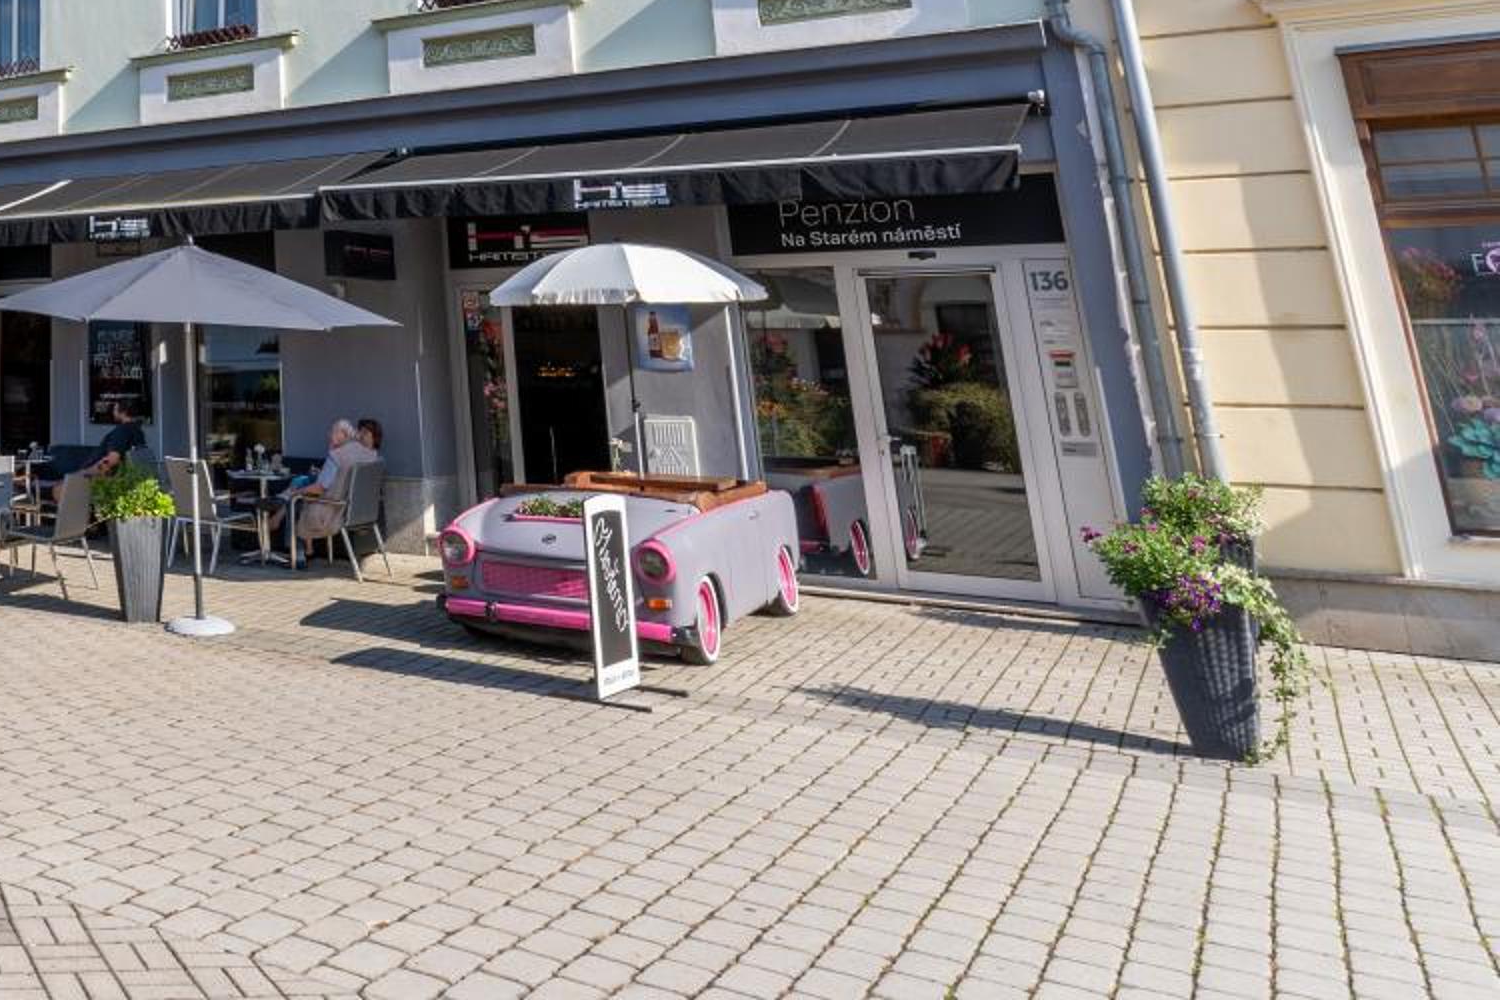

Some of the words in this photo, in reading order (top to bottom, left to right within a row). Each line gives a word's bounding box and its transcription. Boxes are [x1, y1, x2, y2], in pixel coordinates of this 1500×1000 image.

[779, 197, 915, 228] Penzion
[781, 232, 805, 248] Na
[810, 229, 877, 247] Starém
[883, 223, 961, 243] náměstí
[1030, 270, 1069, 292] 136
